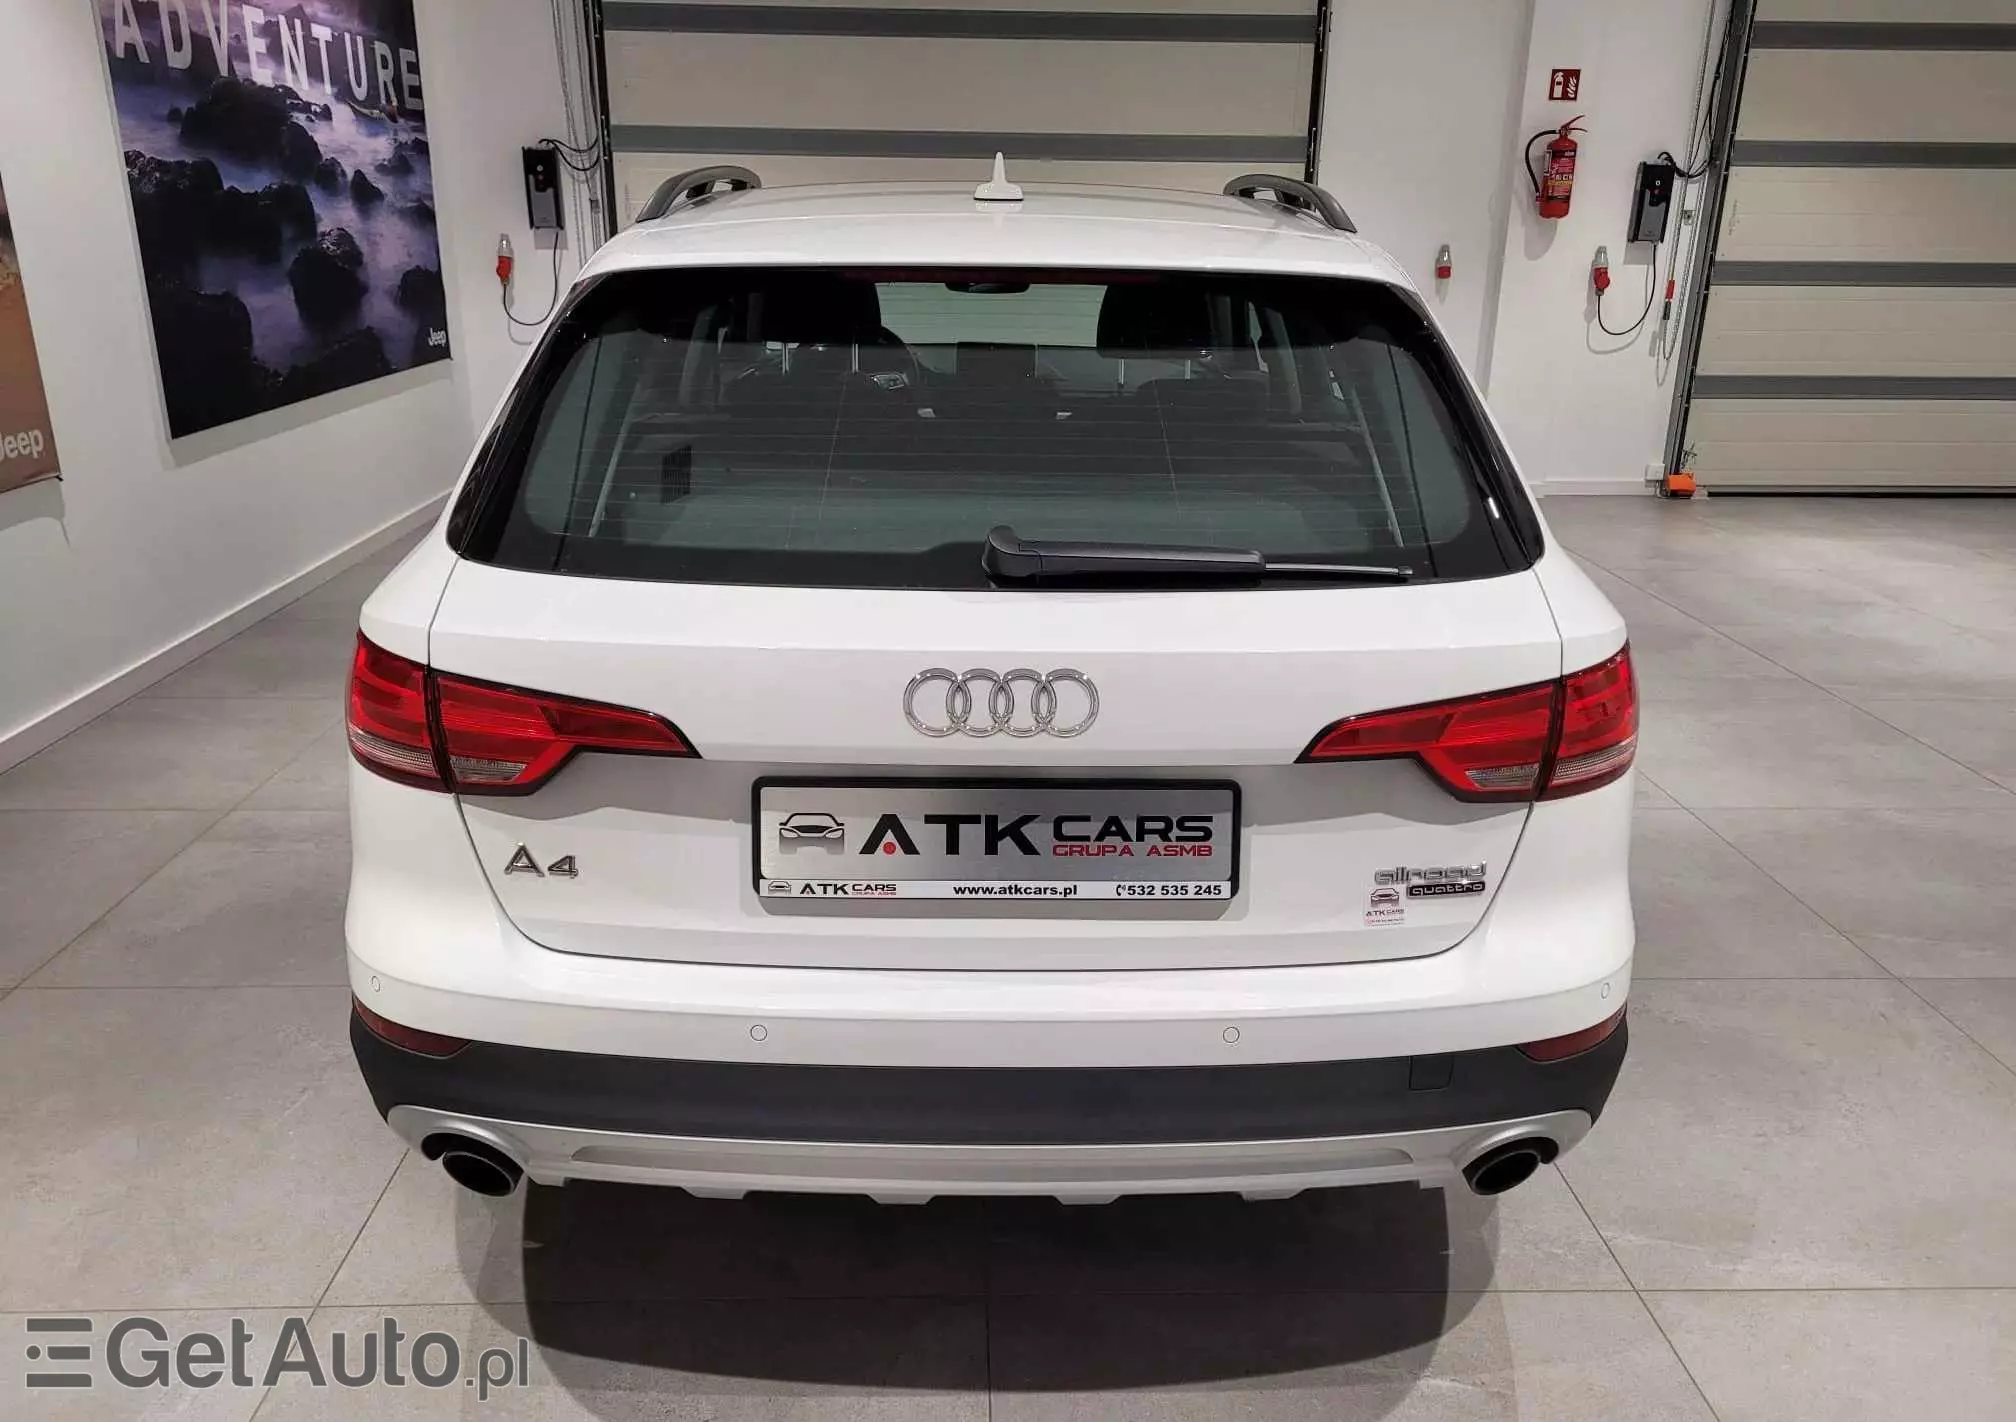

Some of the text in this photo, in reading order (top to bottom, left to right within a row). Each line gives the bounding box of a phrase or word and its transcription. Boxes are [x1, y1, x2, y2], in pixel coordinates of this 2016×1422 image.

[114, 0, 424, 110] ADVENTURE
[428, 327, 447, 348] Jeep
[858, 813, 1214, 856] ATK CARS
[504, 841, 580, 880] A4
[1053, 844, 1213, 857] GRUPA ASMB
[800, 883, 1222, 898] ATK CARS www.atkcars.pl 532 535 245
[1411, 883, 1484, 896] quattro
